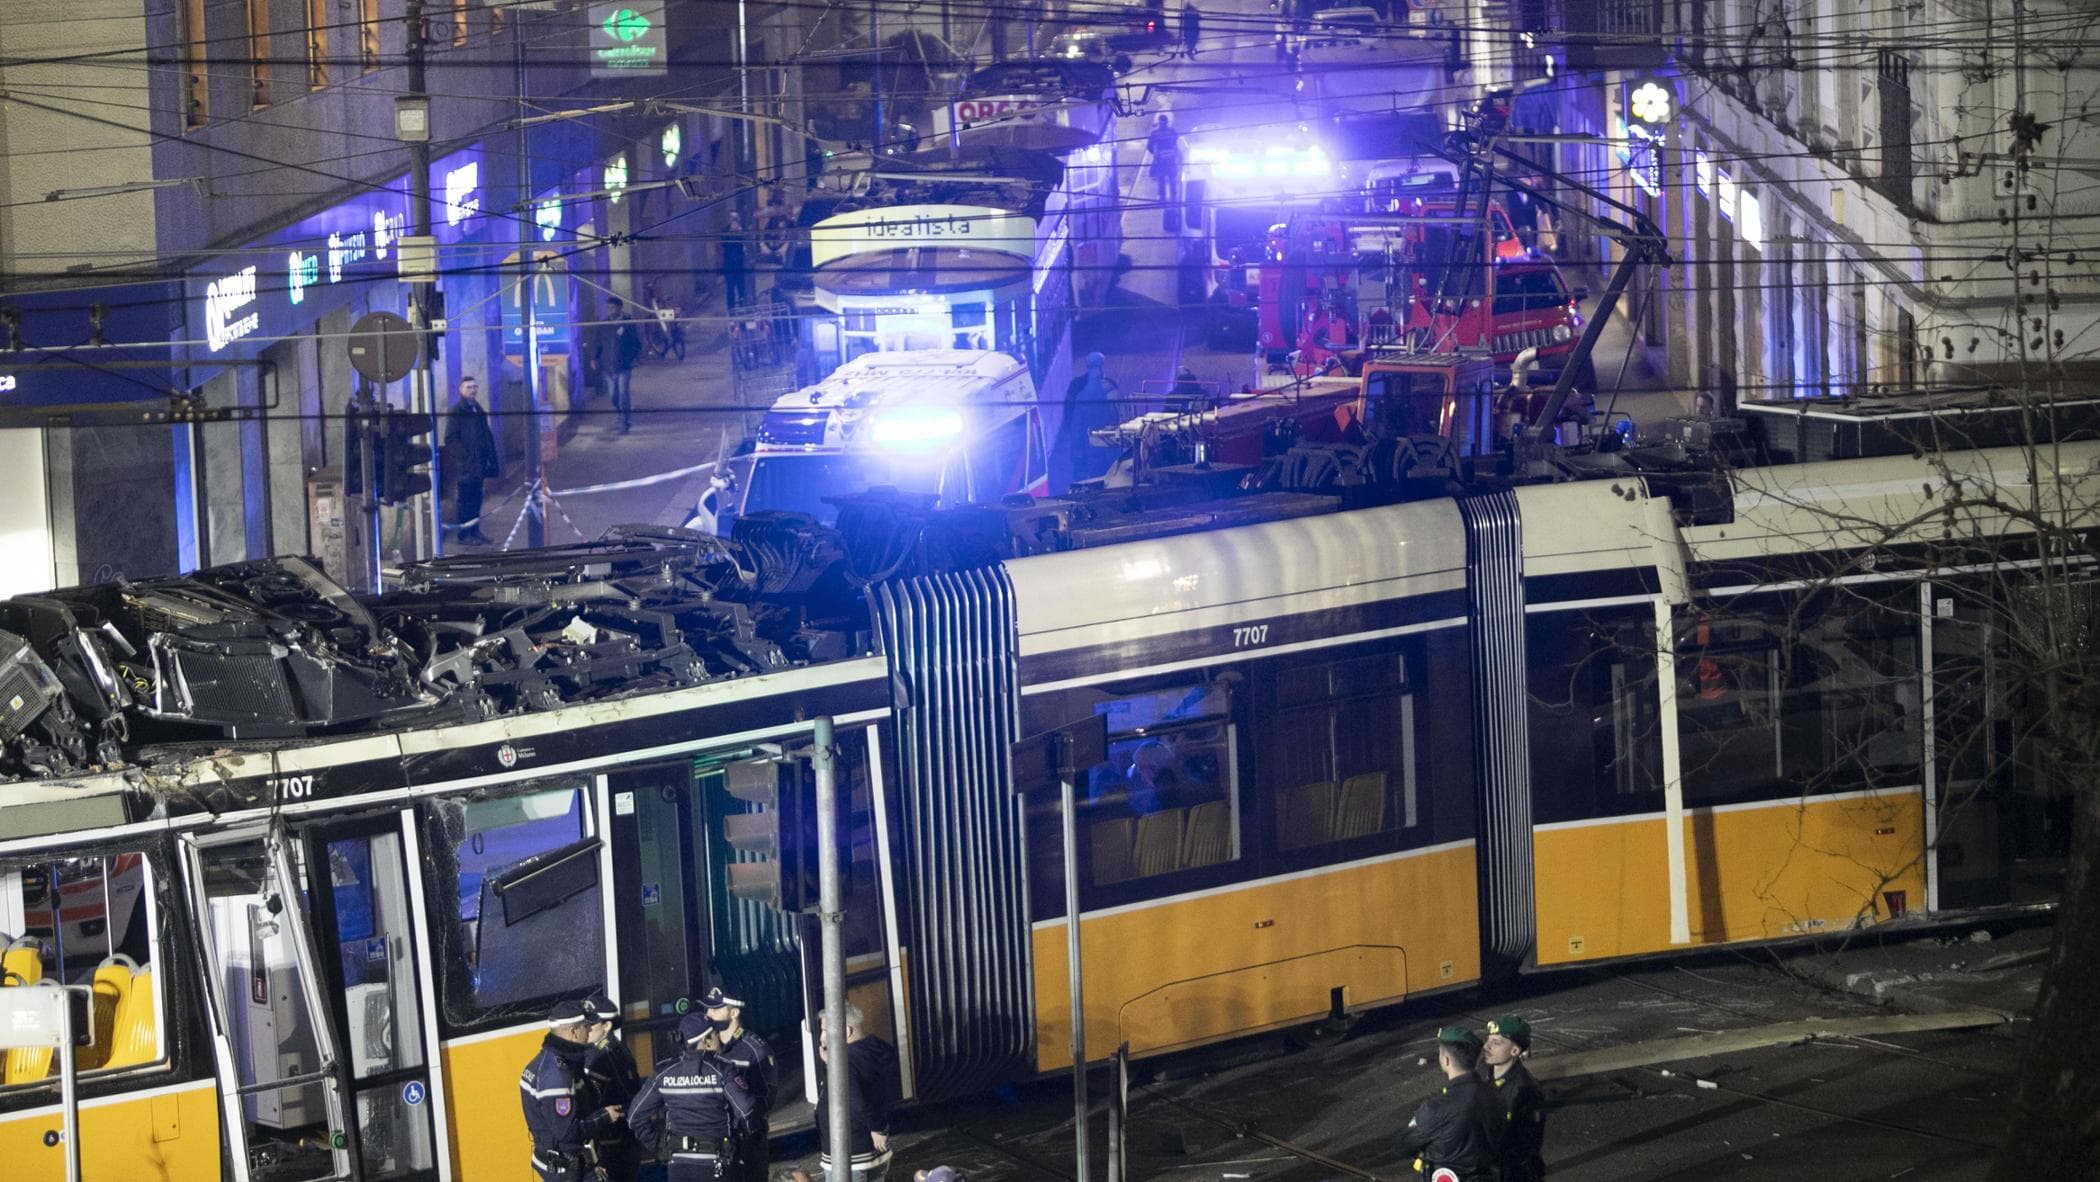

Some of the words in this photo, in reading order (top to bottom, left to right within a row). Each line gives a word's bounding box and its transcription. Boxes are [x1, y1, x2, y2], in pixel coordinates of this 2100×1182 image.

[868, 213, 970, 237] idealista
[1233, 624, 1269, 647] 7707
[266, 775, 313, 800] 7707
[663, 1076, 690, 1087] POLIZIA
[690, 1074, 718, 1086] LOCALE
